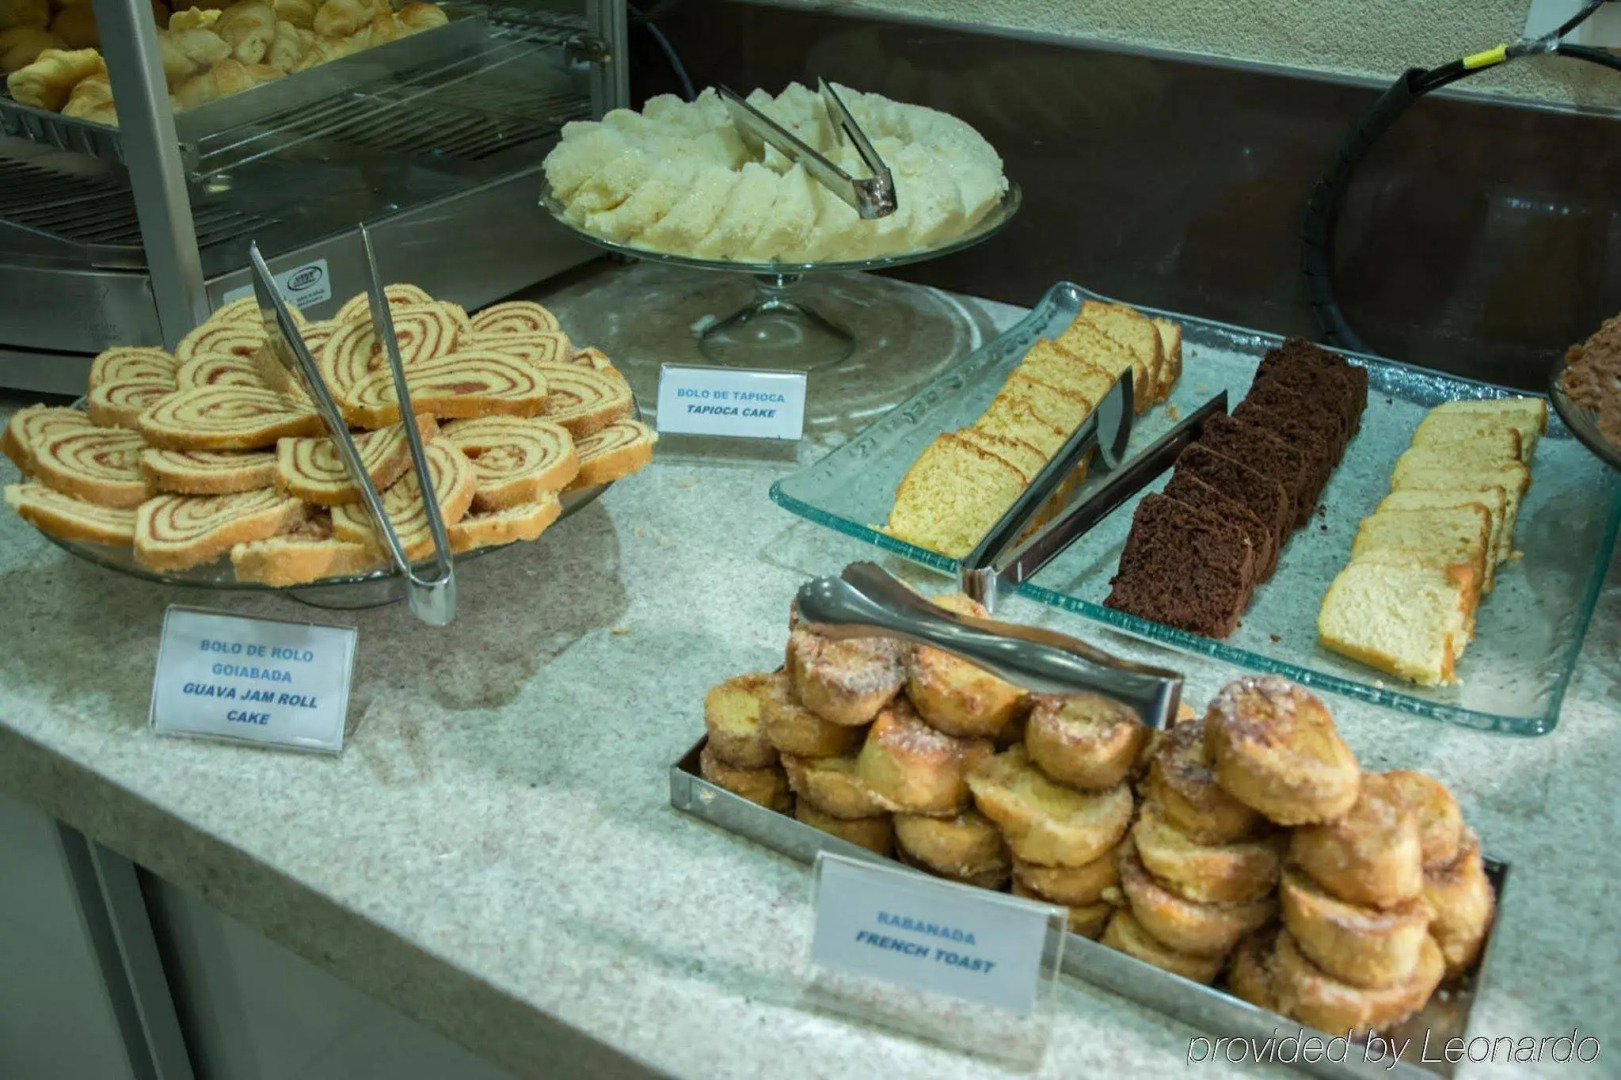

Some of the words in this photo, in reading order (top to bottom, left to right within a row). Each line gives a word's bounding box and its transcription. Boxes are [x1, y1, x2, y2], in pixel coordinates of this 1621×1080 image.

[677, 388, 710, 399] BOLO
[713, 390, 729, 400] DE
[732, 391, 785, 402] TAPIOCA
[687, 404, 739, 416] TAPIOCA
[742, 407, 776, 418] CAKE
[200, 639, 242, 654] BOLO
[246, 644, 266, 658] DE
[270, 647, 314, 663] ROLO
[212, 663, 292, 683] GOIABADA
[183, 682, 236, 699] GUAVA
[240, 689, 275, 704] JAM
[277, 693, 318, 709] ROLL
[226, 710, 271, 726] CAKE
[877, 911, 976, 946] RABANADA
[856, 930, 931, 959] FRENCH
[935, 949, 997, 975] TOAST
